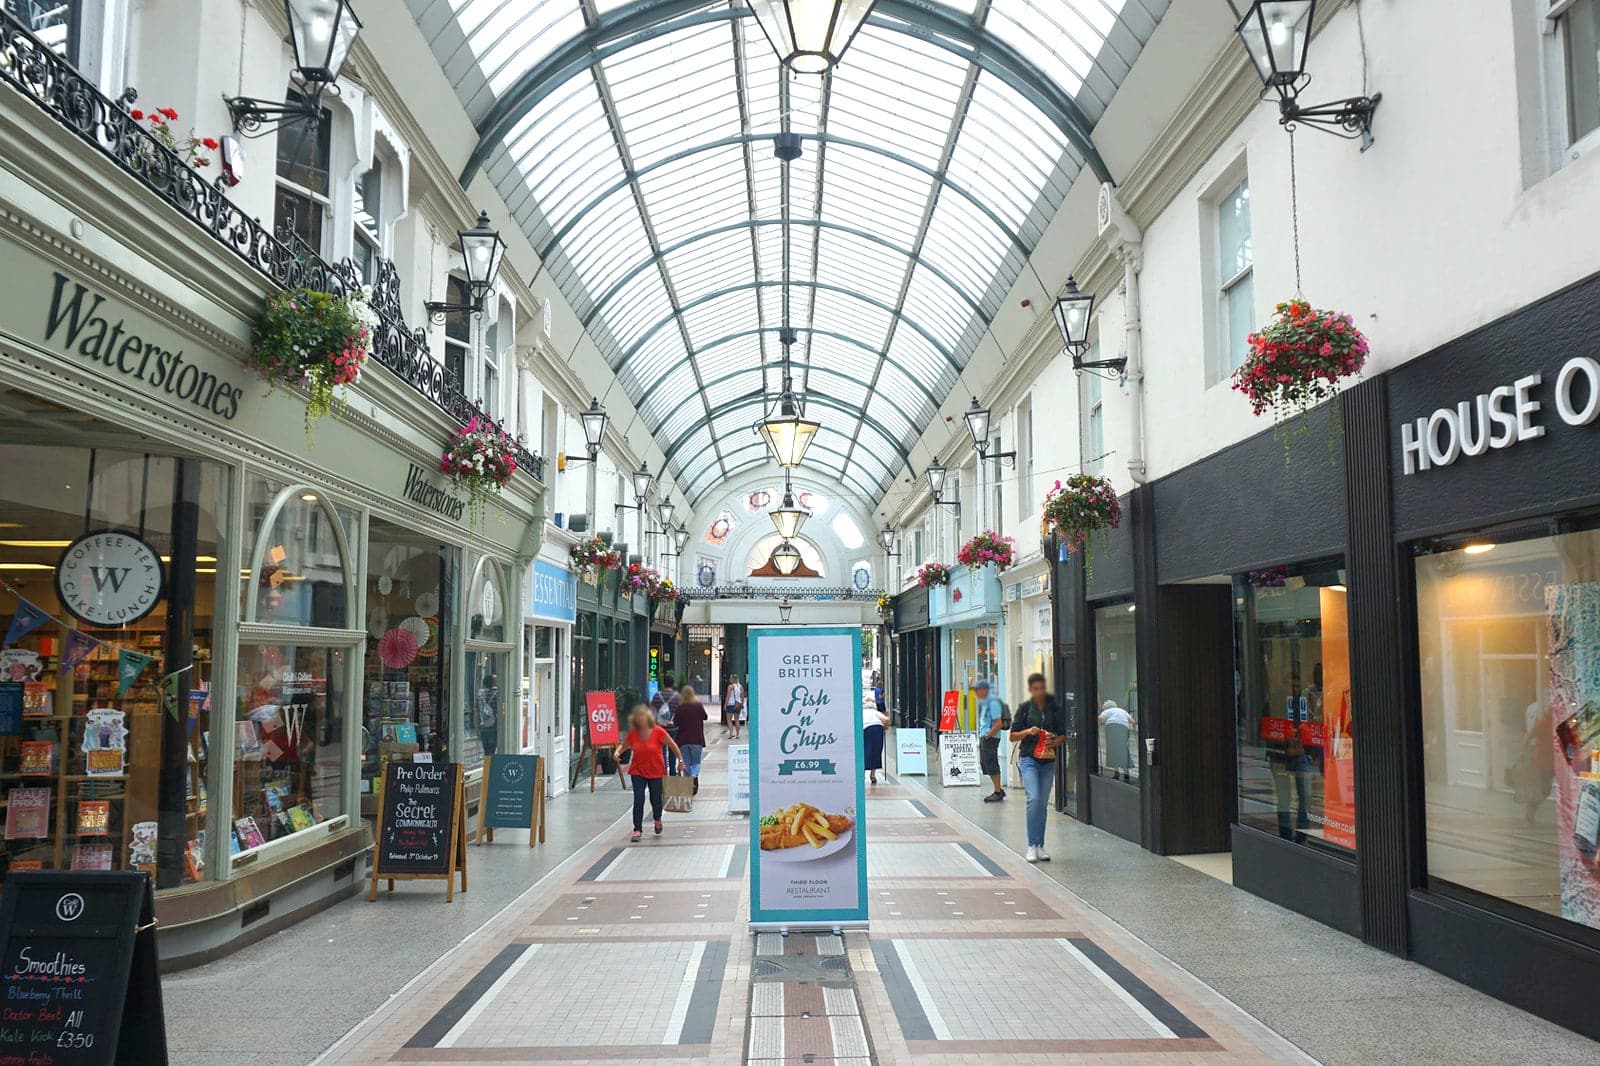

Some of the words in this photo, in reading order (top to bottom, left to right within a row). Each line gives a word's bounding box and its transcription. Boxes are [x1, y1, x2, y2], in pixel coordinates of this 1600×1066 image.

[45, 271, 243, 420] Waterstones
[1401, 374, 1545, 475] HOUSE
[403, 463, 465, 521] Waterstones
[66, 536, 124, 570] COFFEE
[134, 547, 153, 572] TEA
[88, 566, 132, 593] W
[63, 582, 95, 616] CAKE
[107, 585, 155, 620] LUNCH
[782, 654, 829, 665] GREAT
[778, 667, 833, 678] BRITISH
[780, 685, 831, 715] Fish
[592, 709, 614, 722] 60%
[597, 723, 612, 732] OFF
[780, 725, 838, 754] Chips
[396, 766, 413, 780] Pre
[415, 766, 446, 780] Order
[794, 760, 820, 769] £6.99
[395, 802, 437, 819] Secret
[15, 946, 86, 975] Smoothies
[8, 986, 51, 1006] Blueberry
[52, 987, 82, 1000] Thrill
[64, 1010, 84, 1028] All
[0, 1029, 25, 1043] Kale
